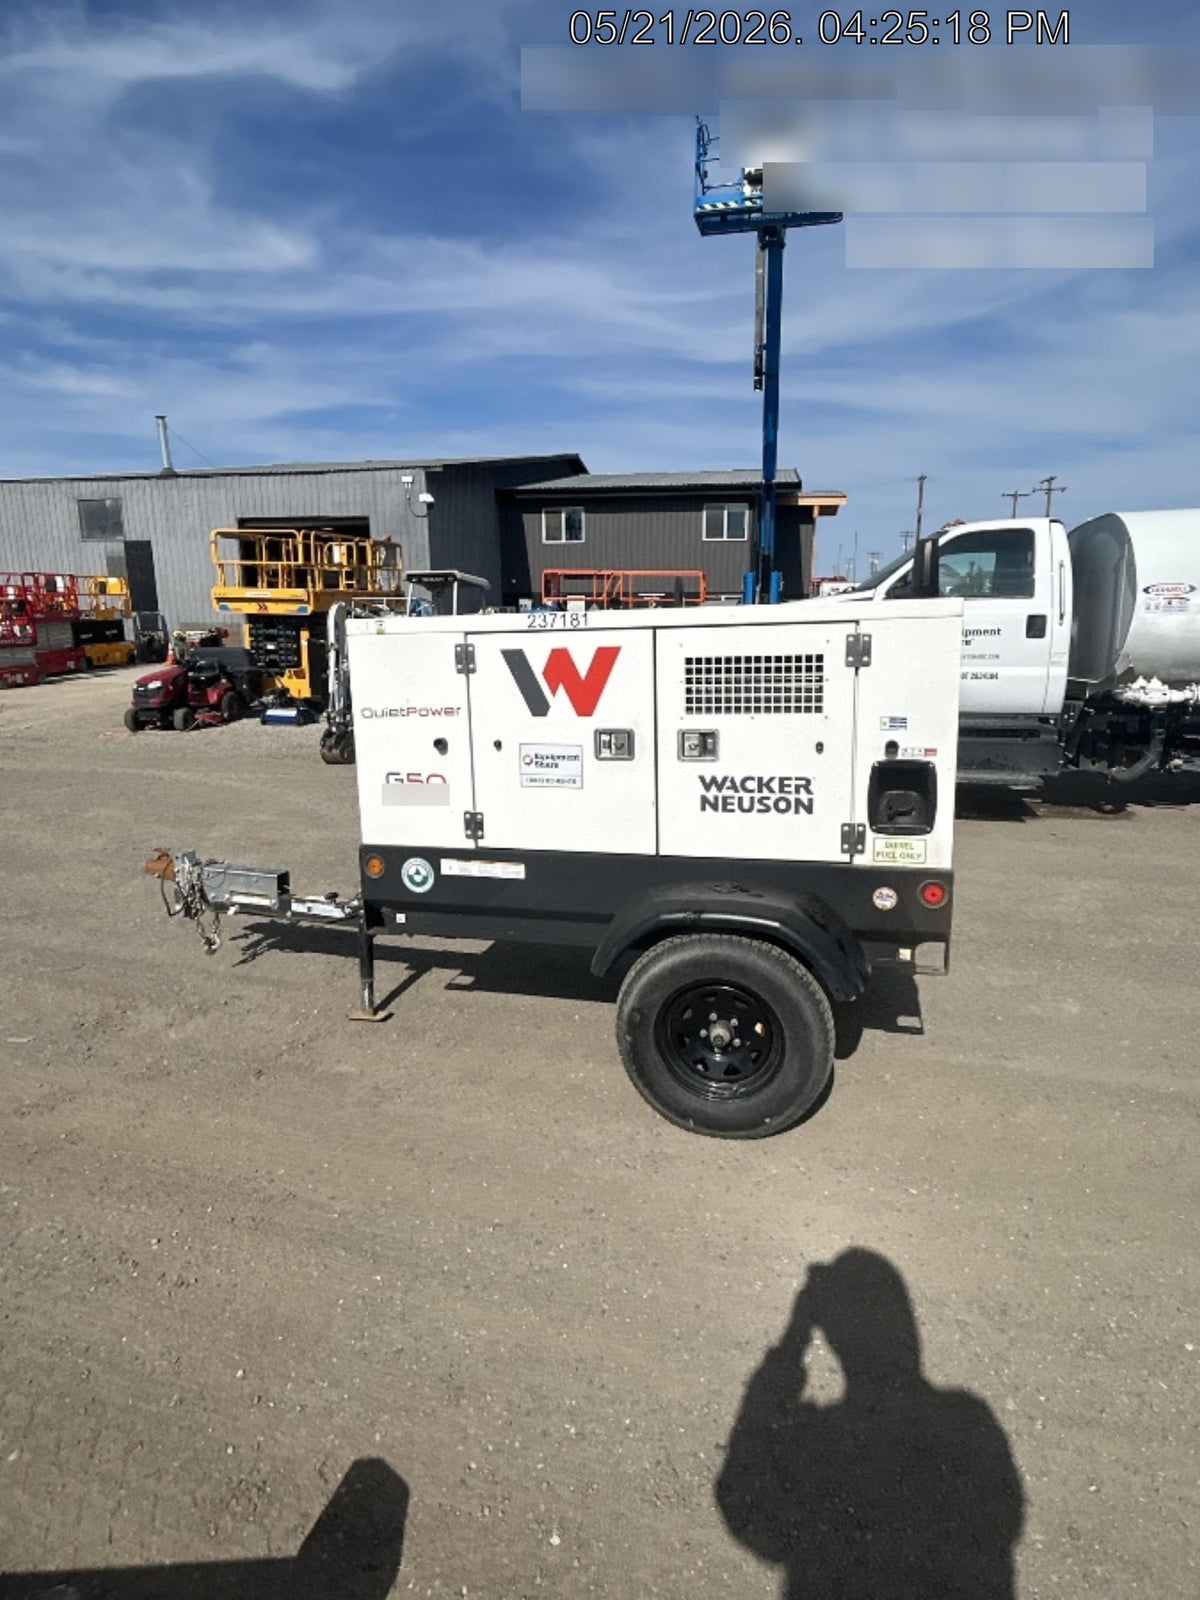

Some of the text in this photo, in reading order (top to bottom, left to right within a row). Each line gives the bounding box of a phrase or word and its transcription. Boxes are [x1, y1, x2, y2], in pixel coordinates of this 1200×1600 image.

[527, 612, 588, 629] 237181
[361, 706, 462, 719] QuietPower
[698, 775, 814, 795] WACKER
[700, 794, 814, 815] NEUSON
